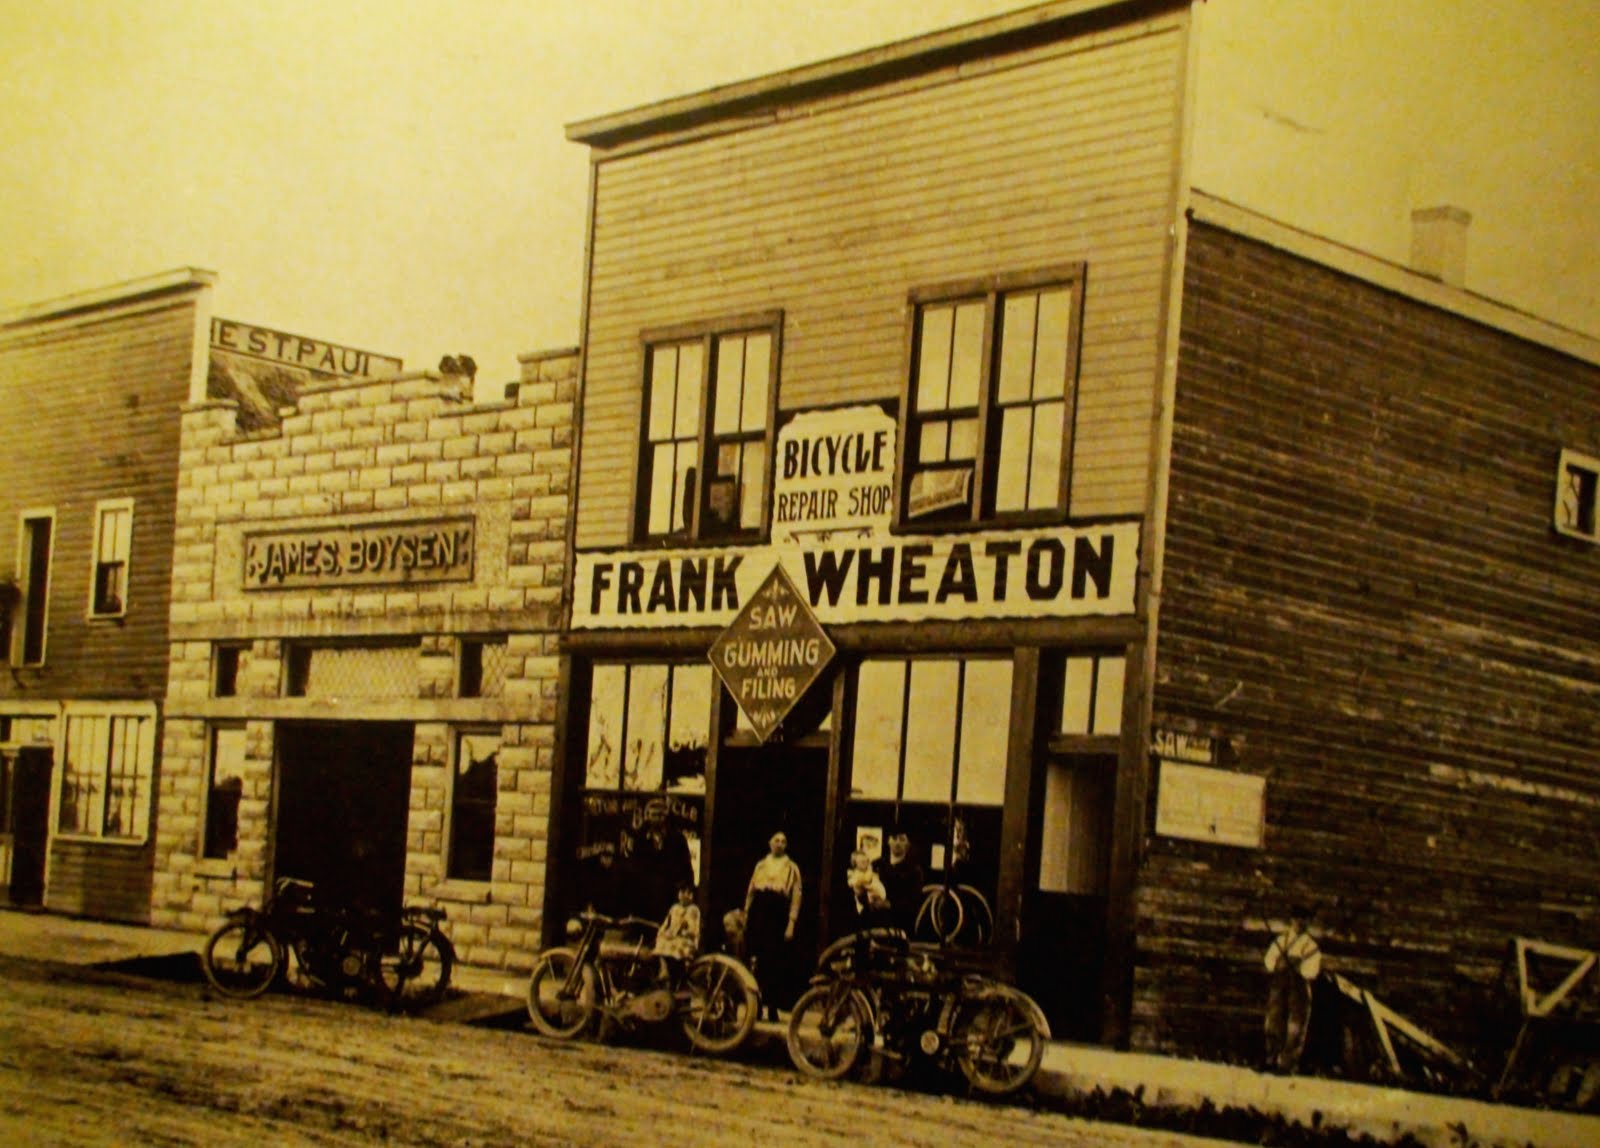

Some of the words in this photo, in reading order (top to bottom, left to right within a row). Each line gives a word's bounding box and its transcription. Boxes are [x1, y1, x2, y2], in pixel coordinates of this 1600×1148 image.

[784, 430, 887, 480] BICYCLE
[777, 489, 838, 523] REPAIR
[847, 483, 891, 517] SHOP
[346, 531, 457, 574] BOYSEN
[589, 556, 744, 616] FRANK
[803, 537, 1115, 607] WHEATON
[749, 605, 797, 630] SAW
[724, 638, 820, 668] GUMMING
[742, 679, 796, 700] FILING
